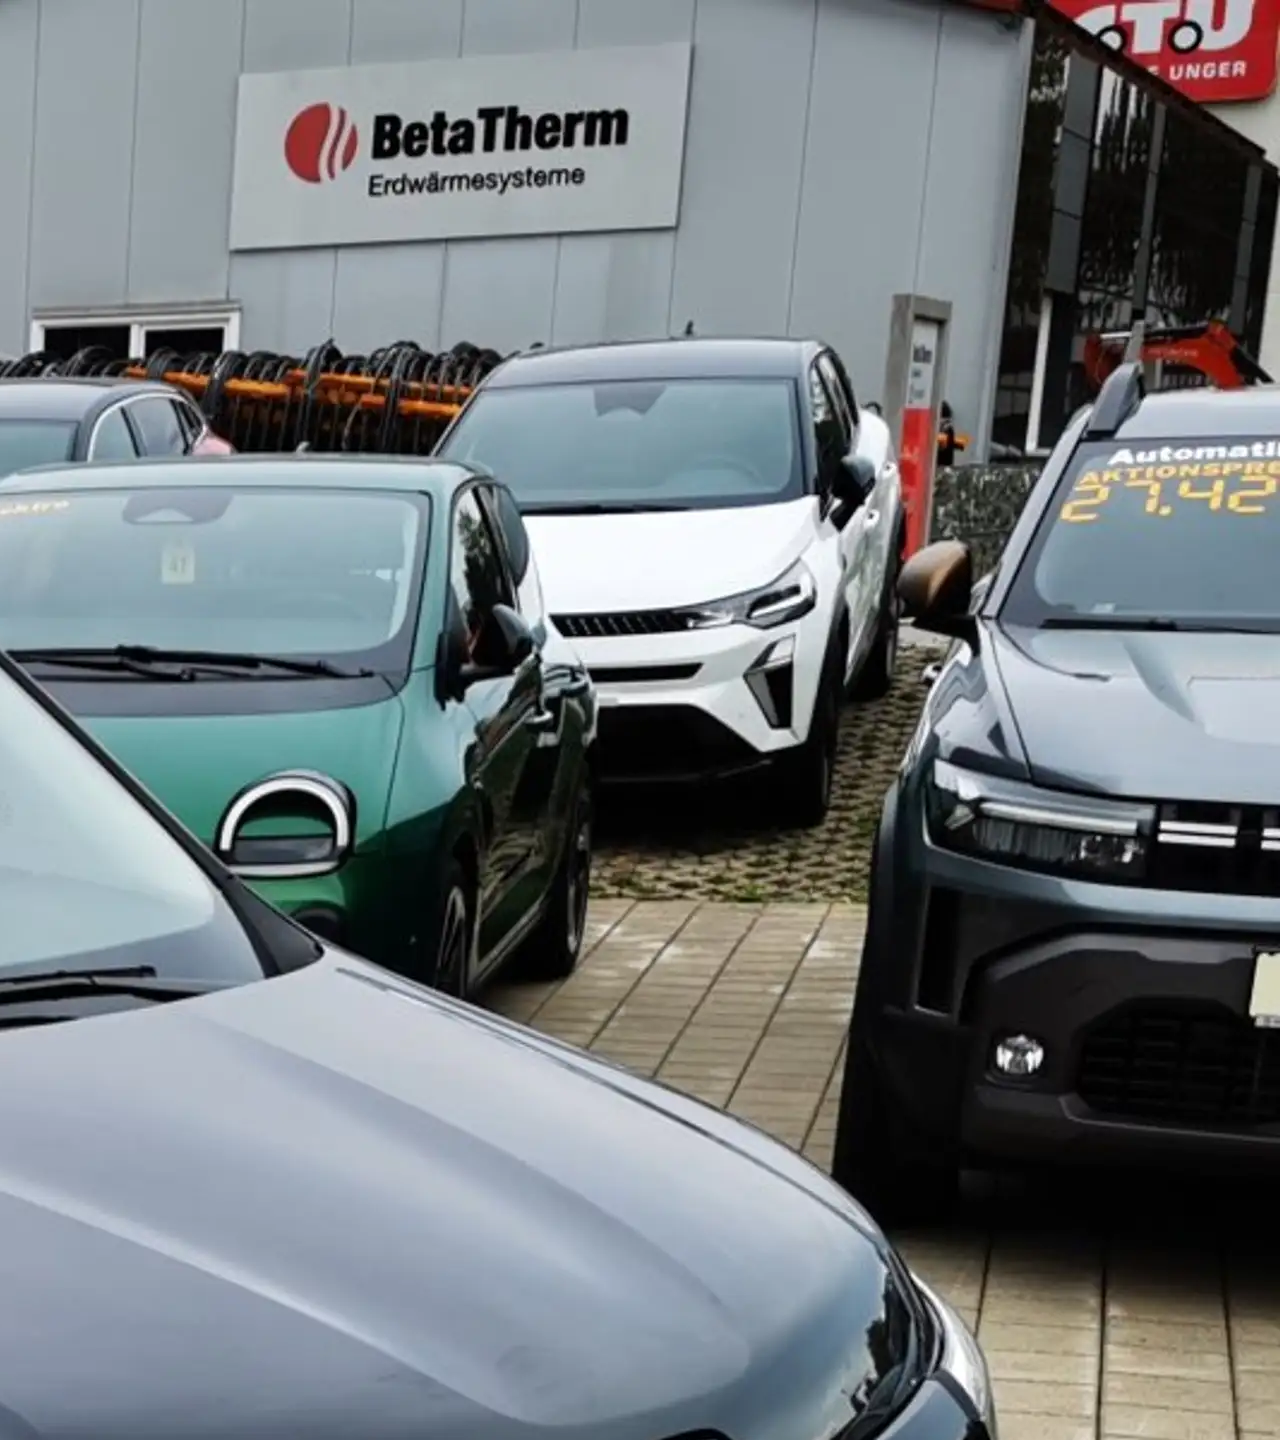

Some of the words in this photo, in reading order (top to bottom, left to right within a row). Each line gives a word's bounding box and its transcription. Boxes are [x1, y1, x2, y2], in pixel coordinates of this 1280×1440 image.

[1169, 60, 1247, 80] UNGER
[372, 106, 628, 159] BetaTherm
[368, 166, 585, 197] Erdwärmesysteme
